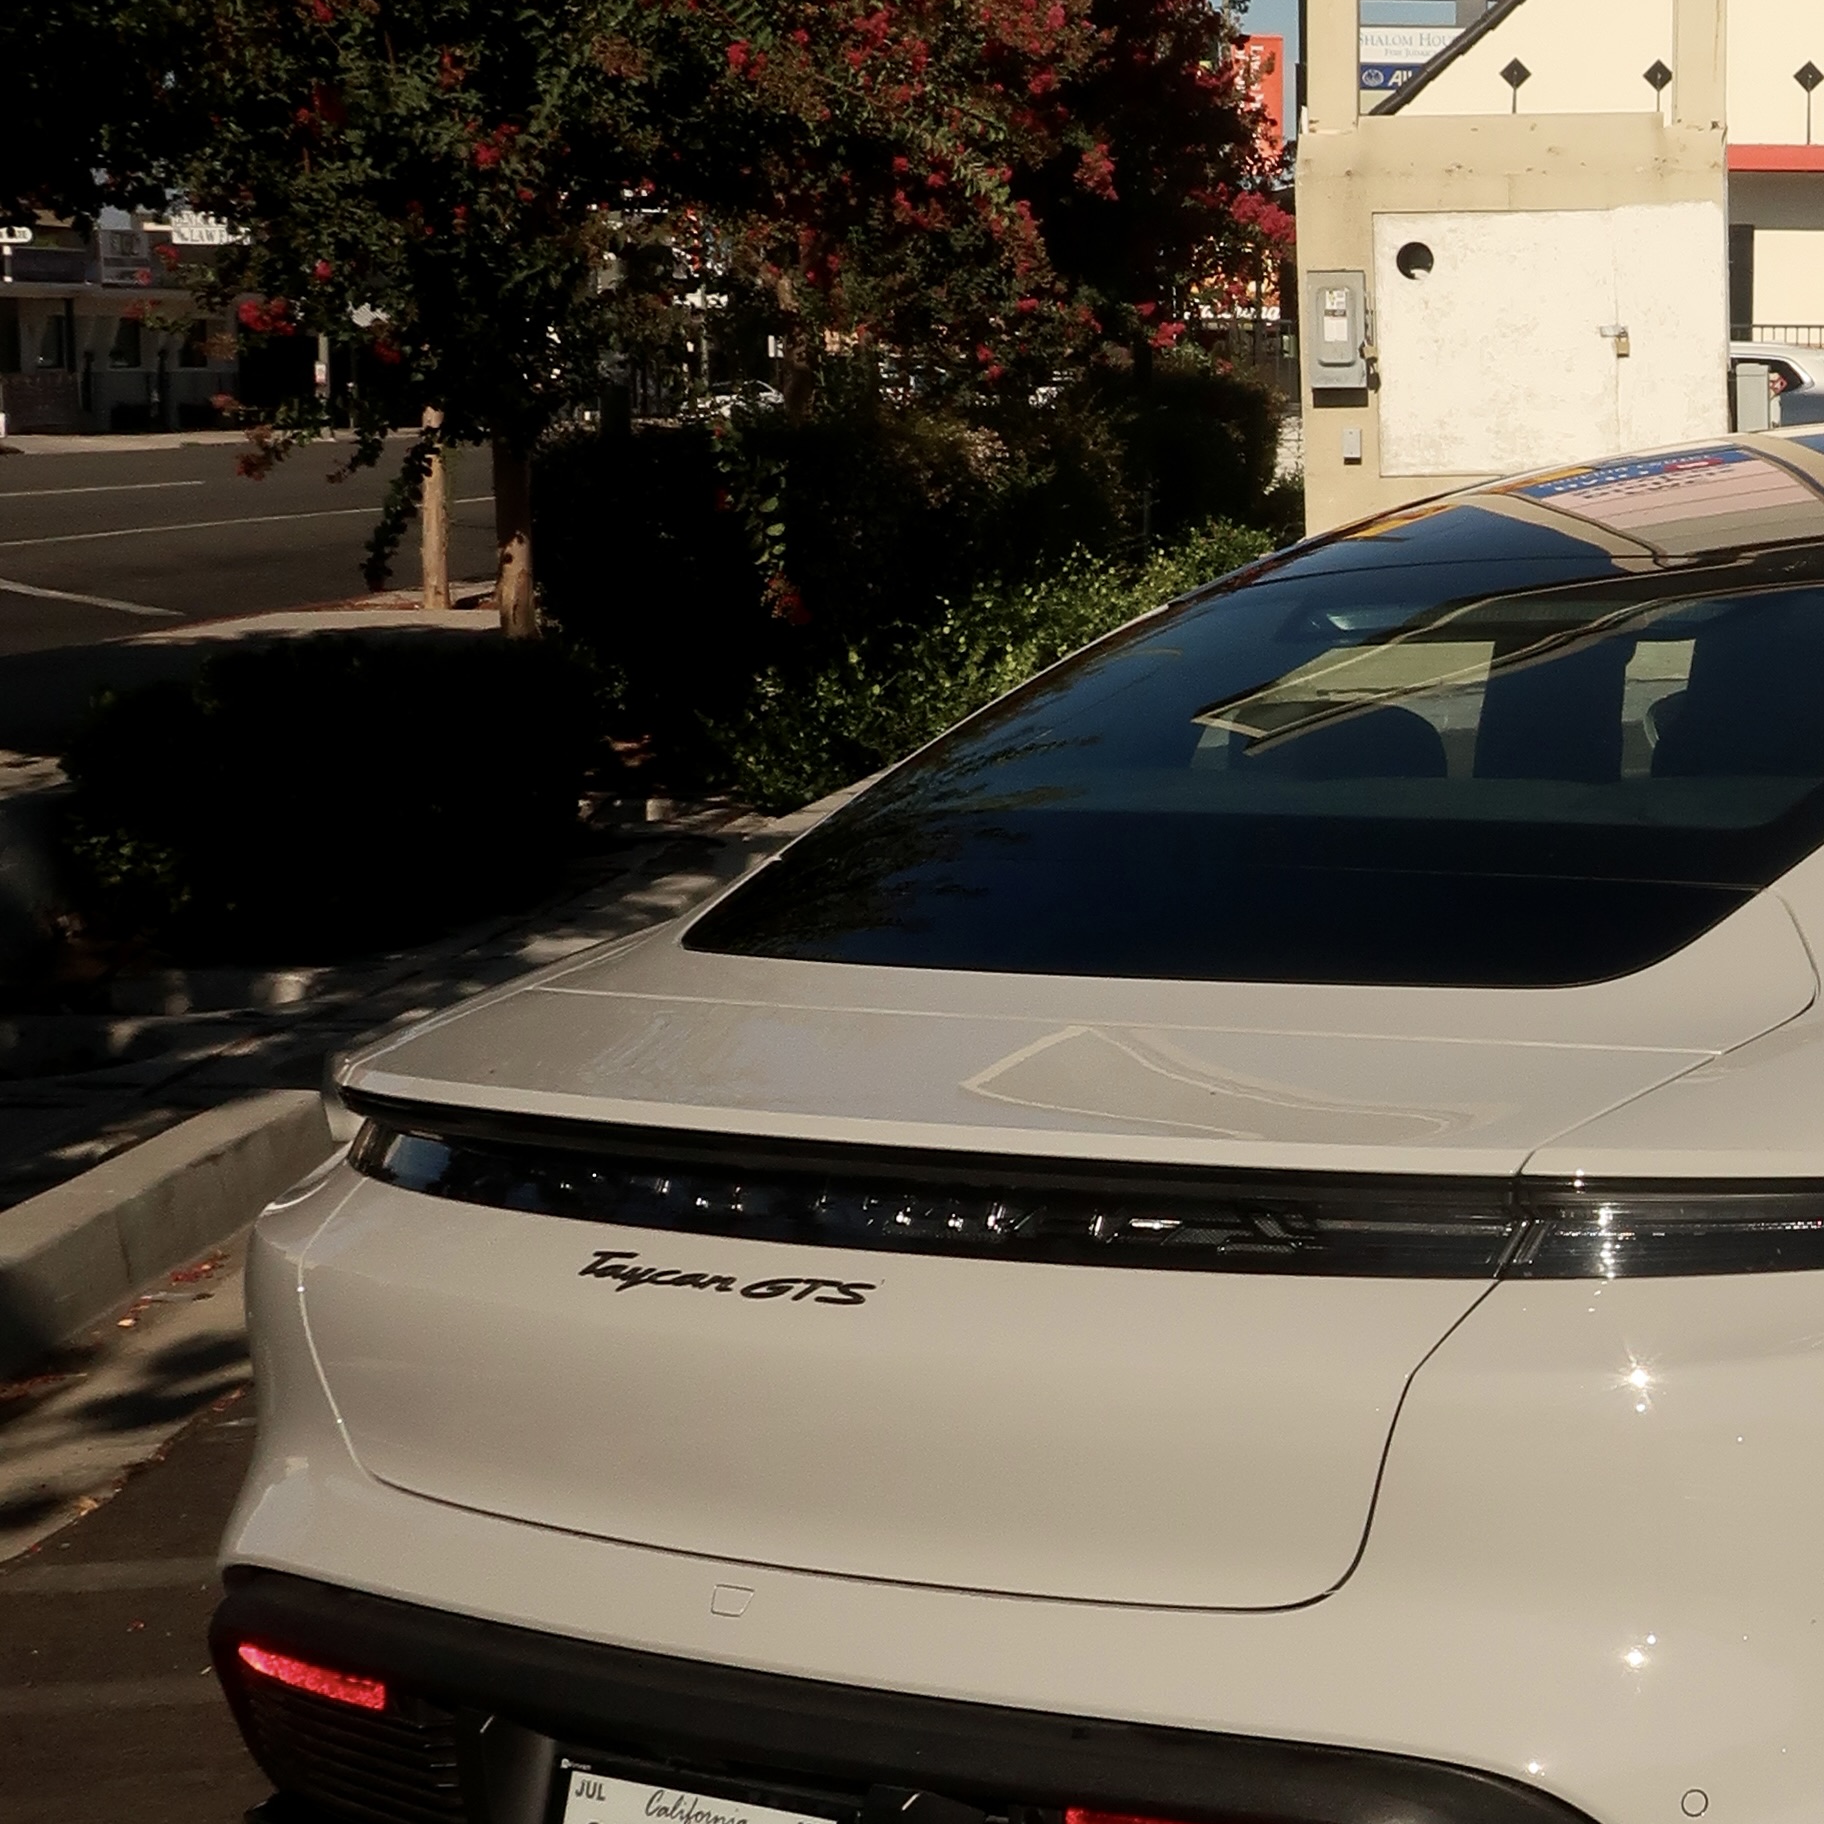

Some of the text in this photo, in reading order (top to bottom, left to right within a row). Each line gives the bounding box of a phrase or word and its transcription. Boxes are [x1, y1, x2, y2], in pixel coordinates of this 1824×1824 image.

[578, 1251, 877, 1306] Taycan GTS
[574, 1778, 607, 1802] JUL
